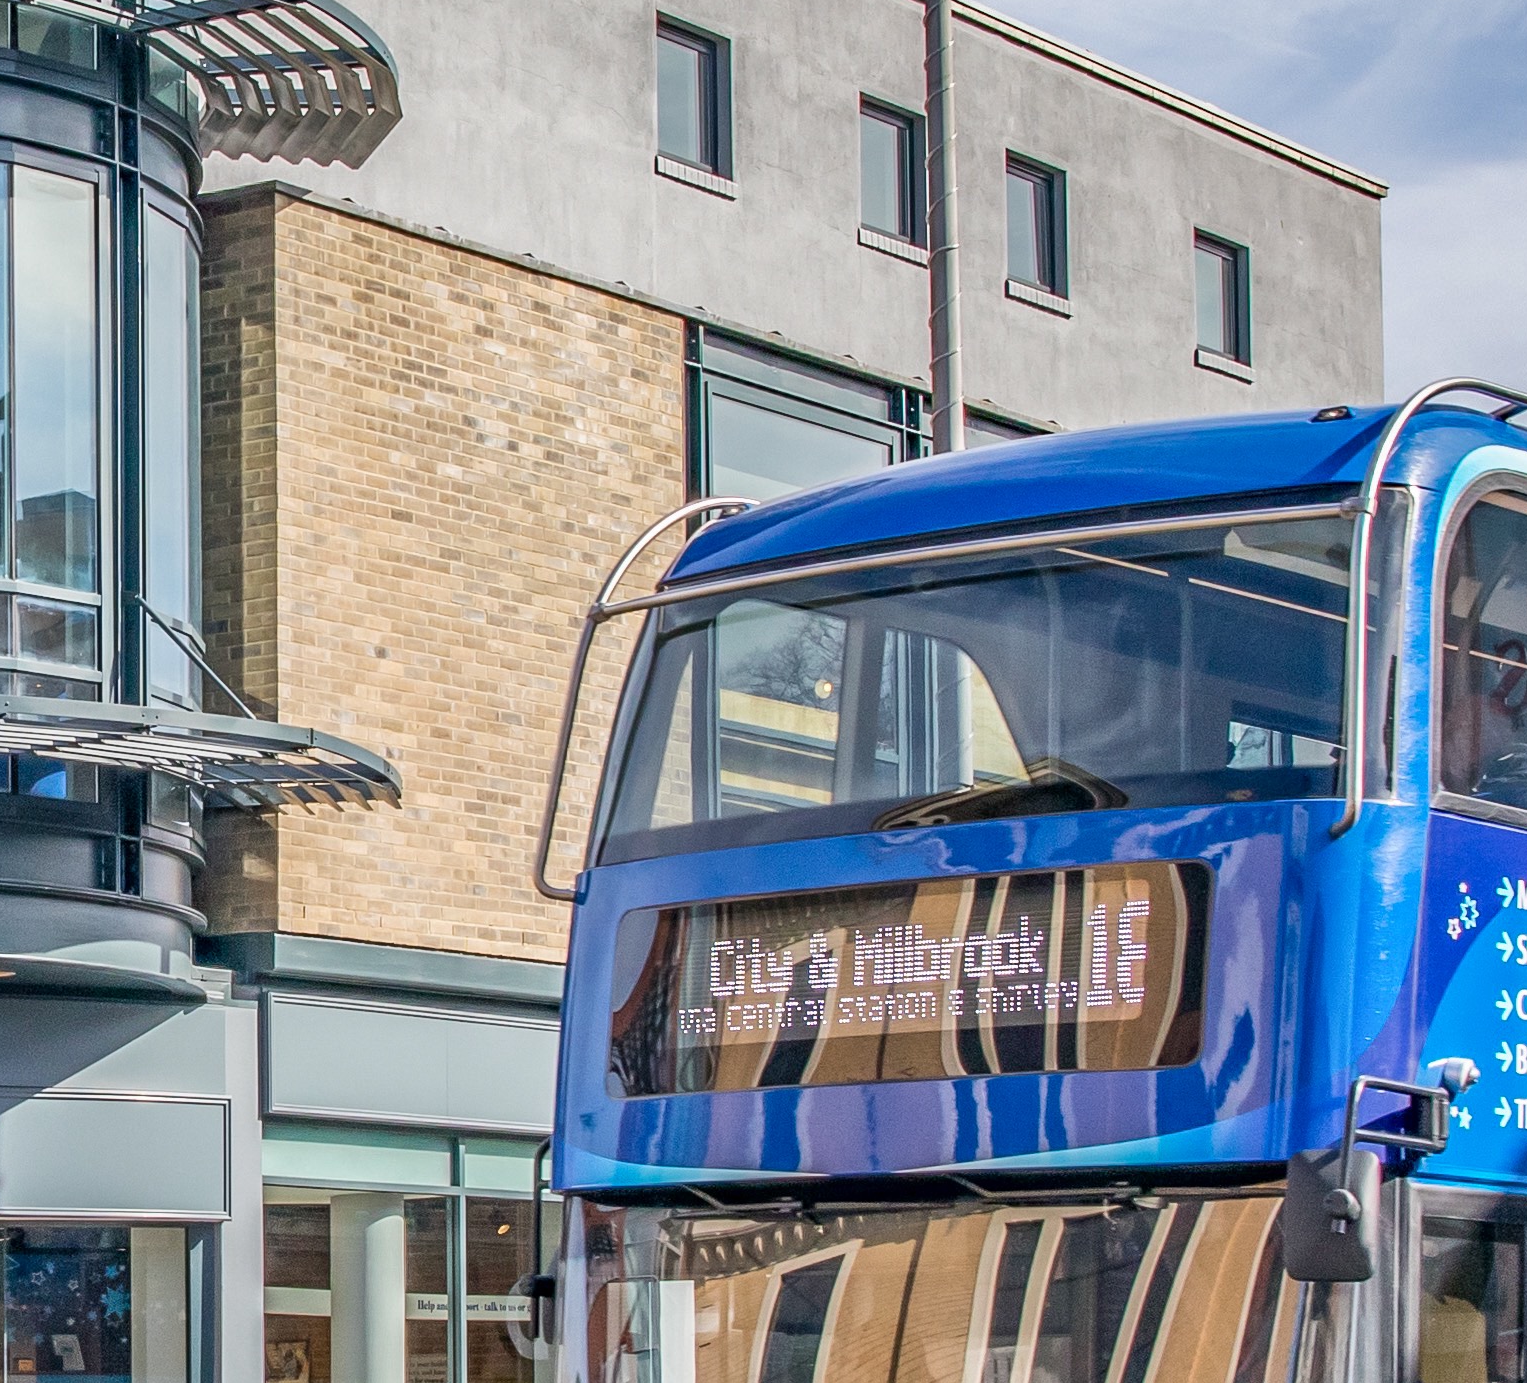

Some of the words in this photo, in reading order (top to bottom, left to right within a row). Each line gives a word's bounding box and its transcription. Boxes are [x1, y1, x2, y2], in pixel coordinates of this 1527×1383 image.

[710, 938, 794, 997] City
[808, 932, 839, 989] &
[854, 916, 1043, 986] Millbrook
[839, 990, 938, 1024] Station
[975, 982, 1079, 1015] Shirley
[417, 1300, 435, 1313] Help
[484, 1302, 498, 1311] talk
[499, 1303, 507, 1312] to
